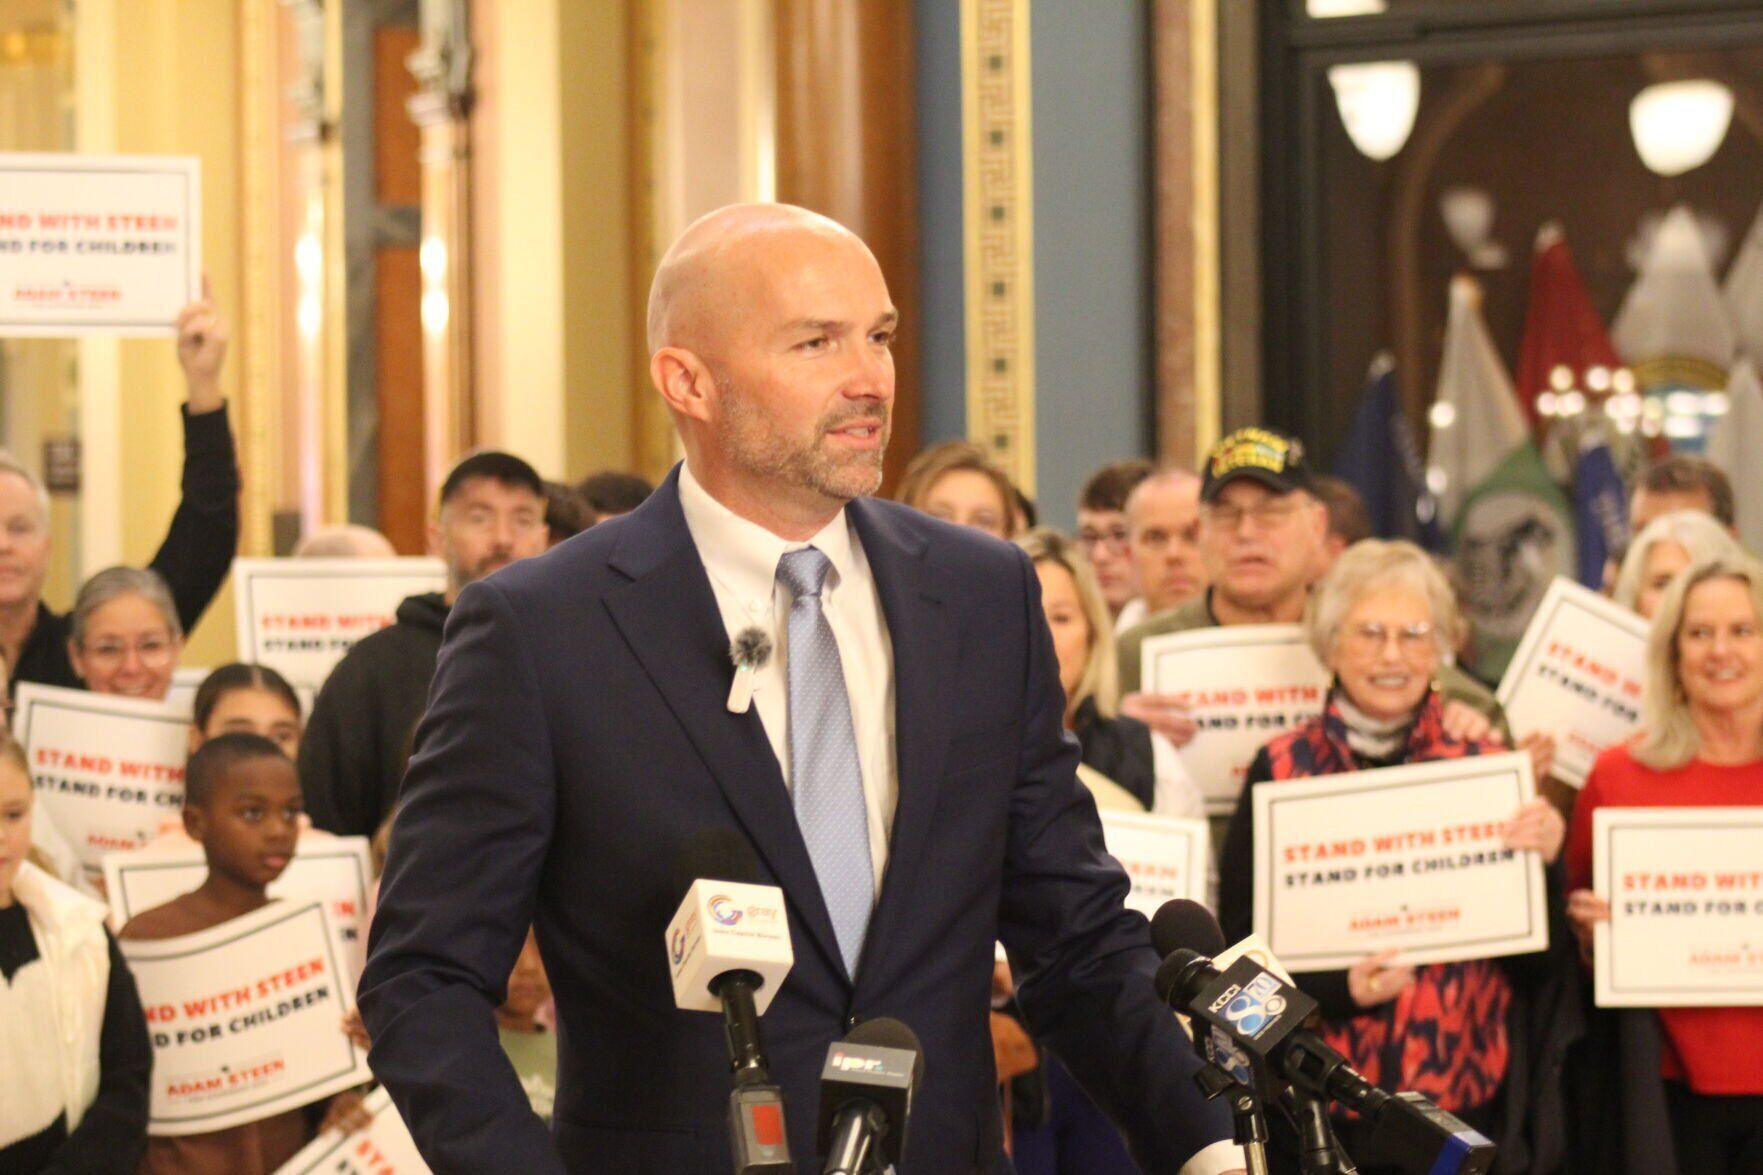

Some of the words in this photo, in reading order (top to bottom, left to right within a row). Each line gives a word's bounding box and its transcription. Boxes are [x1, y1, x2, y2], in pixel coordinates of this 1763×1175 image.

[39, 214, 100, 230] WITH
[30, 240, 67, 252] FOR
[76, 241, 175, 254] CHILDREN
[37, 749, 112, 773] STAND
[36, 776, 100, 797] STAND
[106, 787, 147, 801] FOR
[1285, 839, 1365, 863] STAND
[1373, 830, 1434, 851] WITH
[1286, 871, 1357, 888] STAND
[1365, 864, 1404, 878] FOR
[1412, 848, 1515, 873] CHILDREN
[1623, 873, 1707, 891] STAND
[1714, 873, 1763, 890] WIT
[1625, 902, 1697, 916] STAND
[1705, 901, 1747, 915] FOR
[183, 988, 251, 1019] WITH
[256, 958, 325, 998] STEEN
[1208, 984, 1241, 1013] KCCI
[176, 1024, 222, 1046] FOR
[229, 986, 329, 1033] CHILDREN
[167, 1076, 222, 1097] ADAM
[229, 1058, 285, 1083] STEEN
